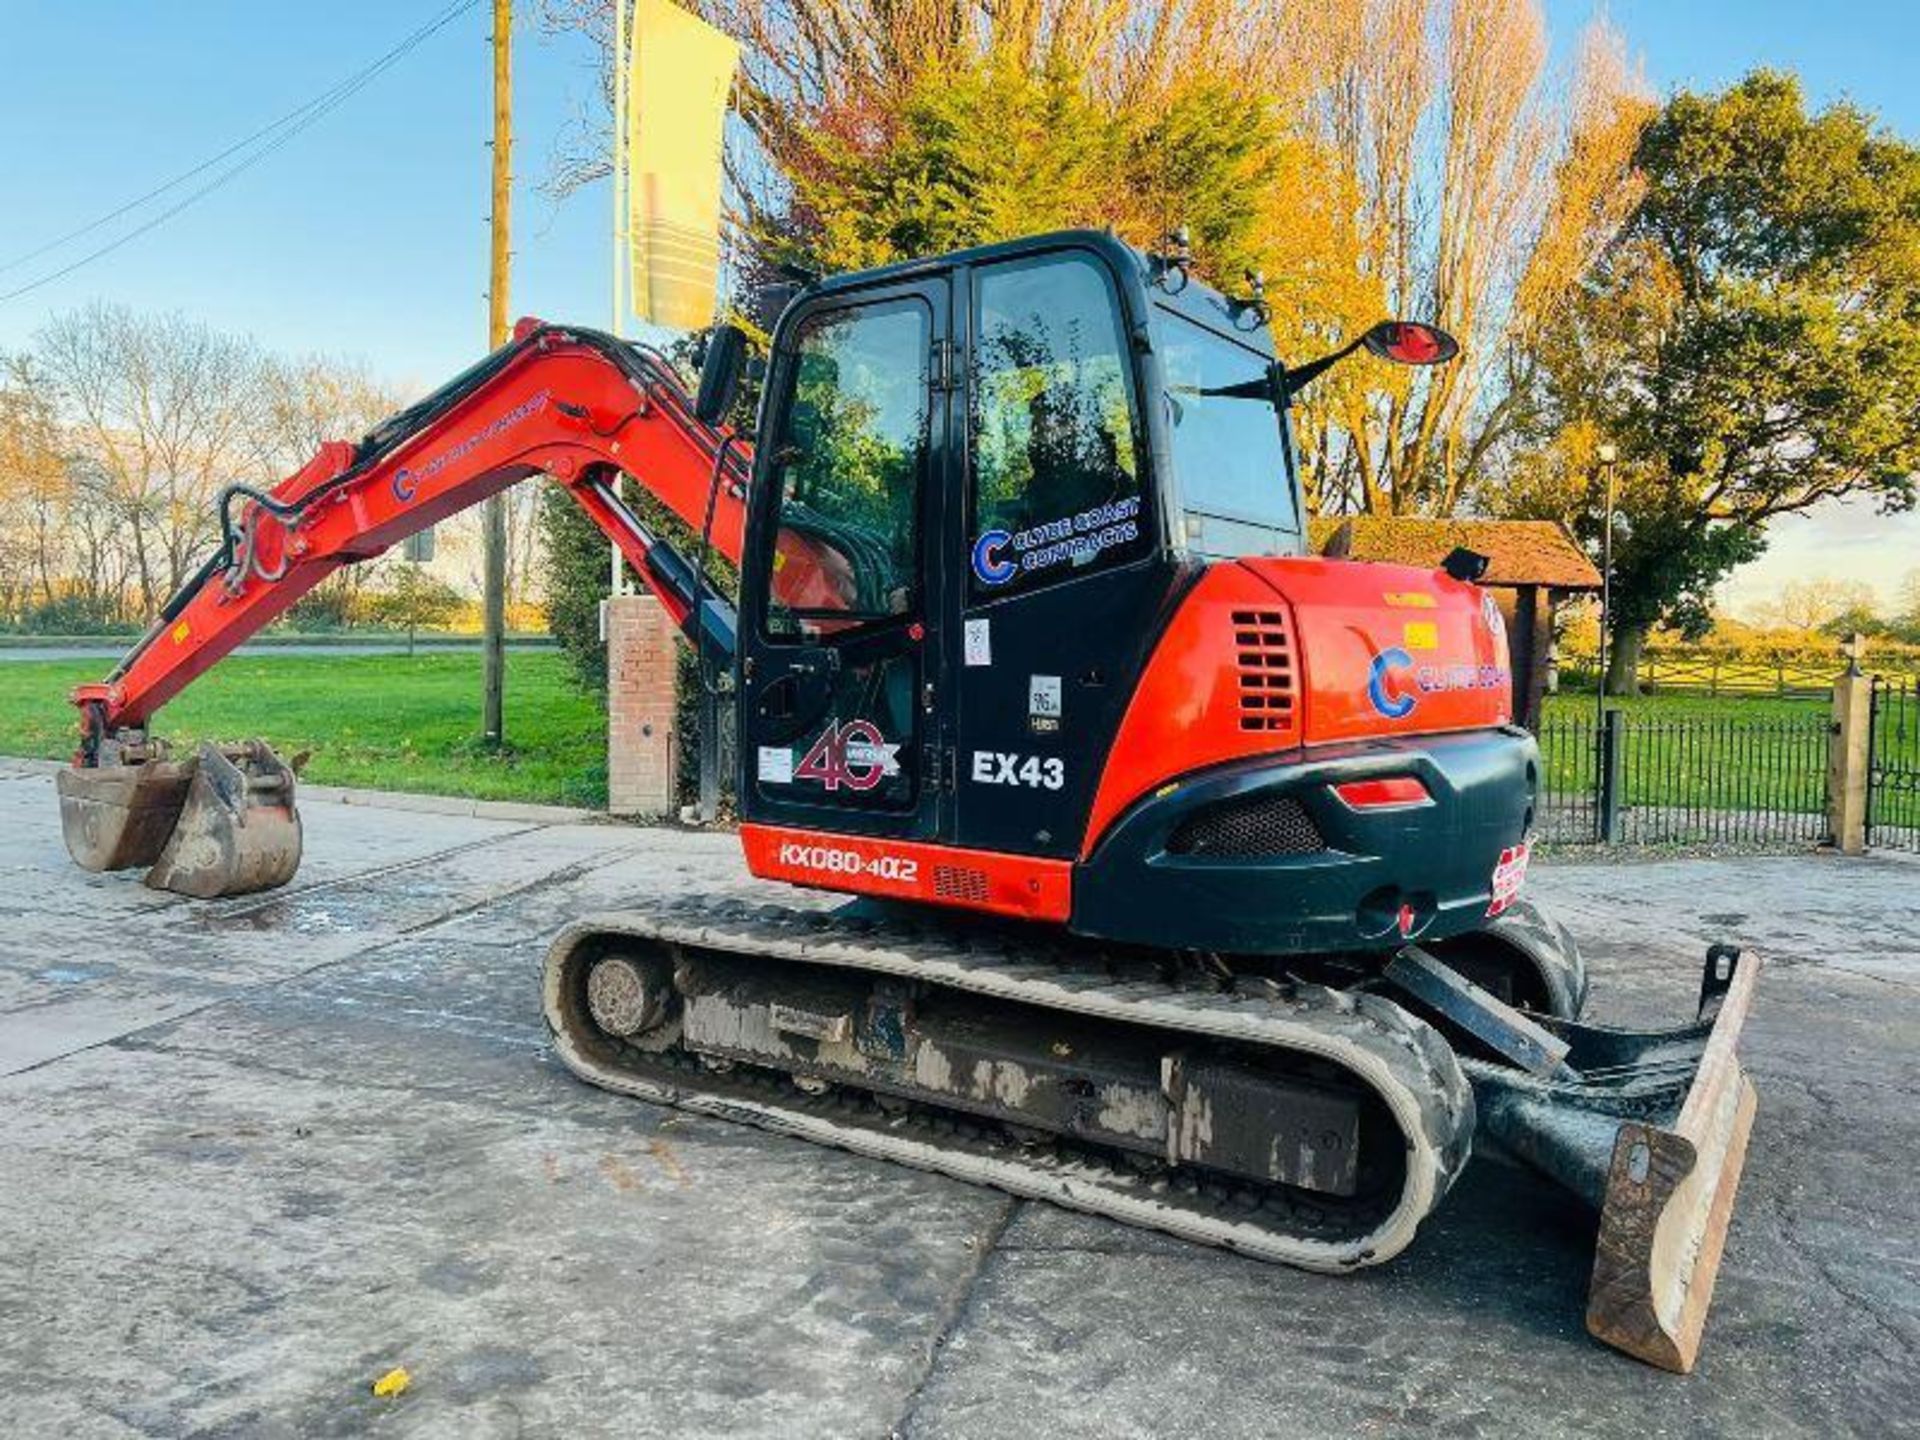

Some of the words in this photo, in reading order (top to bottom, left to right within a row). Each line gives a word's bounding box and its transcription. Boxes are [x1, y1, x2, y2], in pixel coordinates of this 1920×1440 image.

[1012, 518, 1073, 550] CLYDE
[1073, 496, 1141, 531] COAST
[1022, 520, 1139, 570] CONTRACTS
[972, 529, 1018, 584] C
[1368, 646, 1417, 719] C
[793, 717, 885, 790] 40
[972, 750, 1064, 790] EX43
